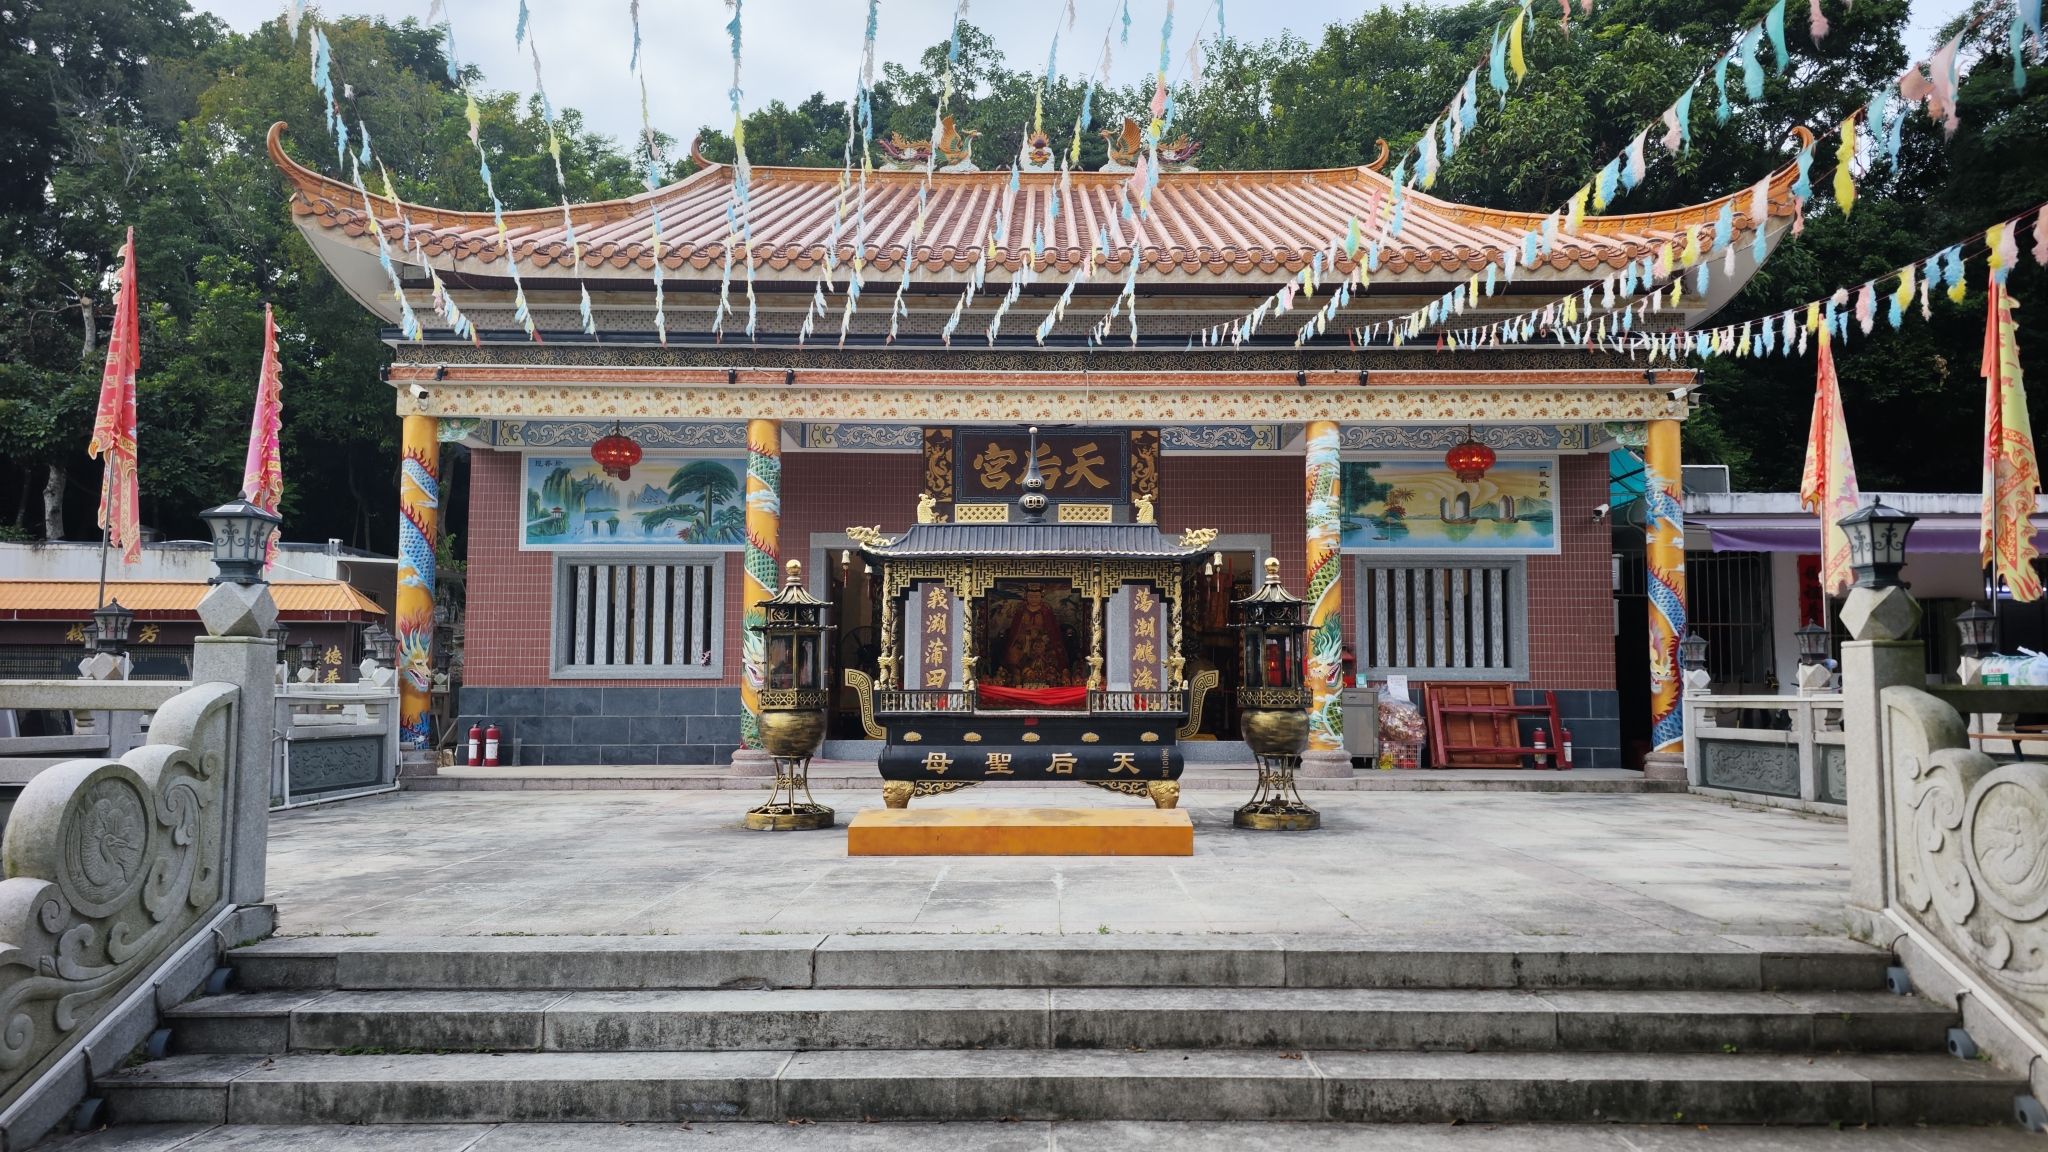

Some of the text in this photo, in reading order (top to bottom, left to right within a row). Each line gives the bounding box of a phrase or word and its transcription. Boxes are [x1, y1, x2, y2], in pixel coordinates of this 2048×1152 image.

[973, 442, 1111, 490] 天后宮
[921, 751, 1141, 775] 天后聖母
